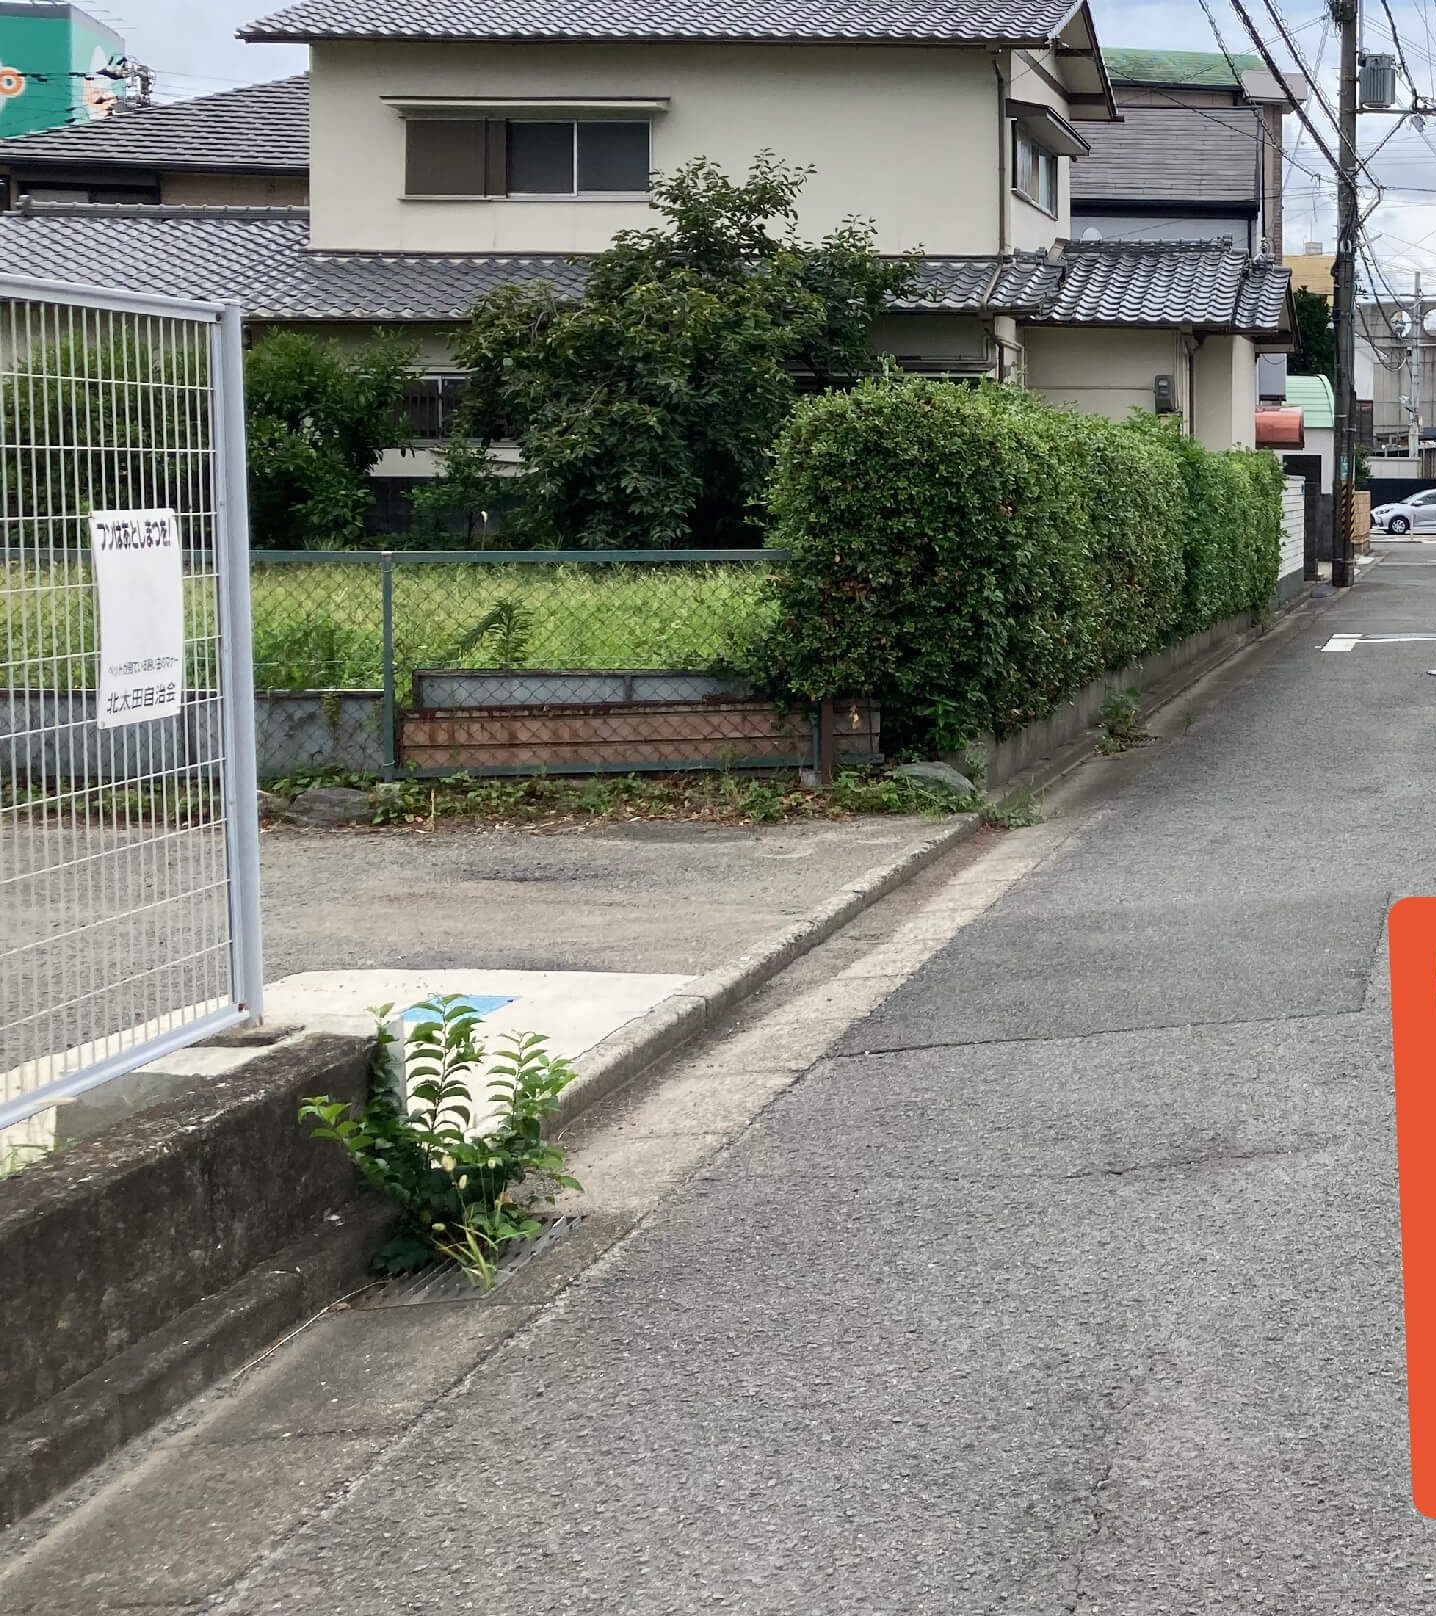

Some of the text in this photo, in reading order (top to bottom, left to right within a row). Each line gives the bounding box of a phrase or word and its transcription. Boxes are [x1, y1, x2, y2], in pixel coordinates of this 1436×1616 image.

[107, 682, 176, 713] 北太田自治会
